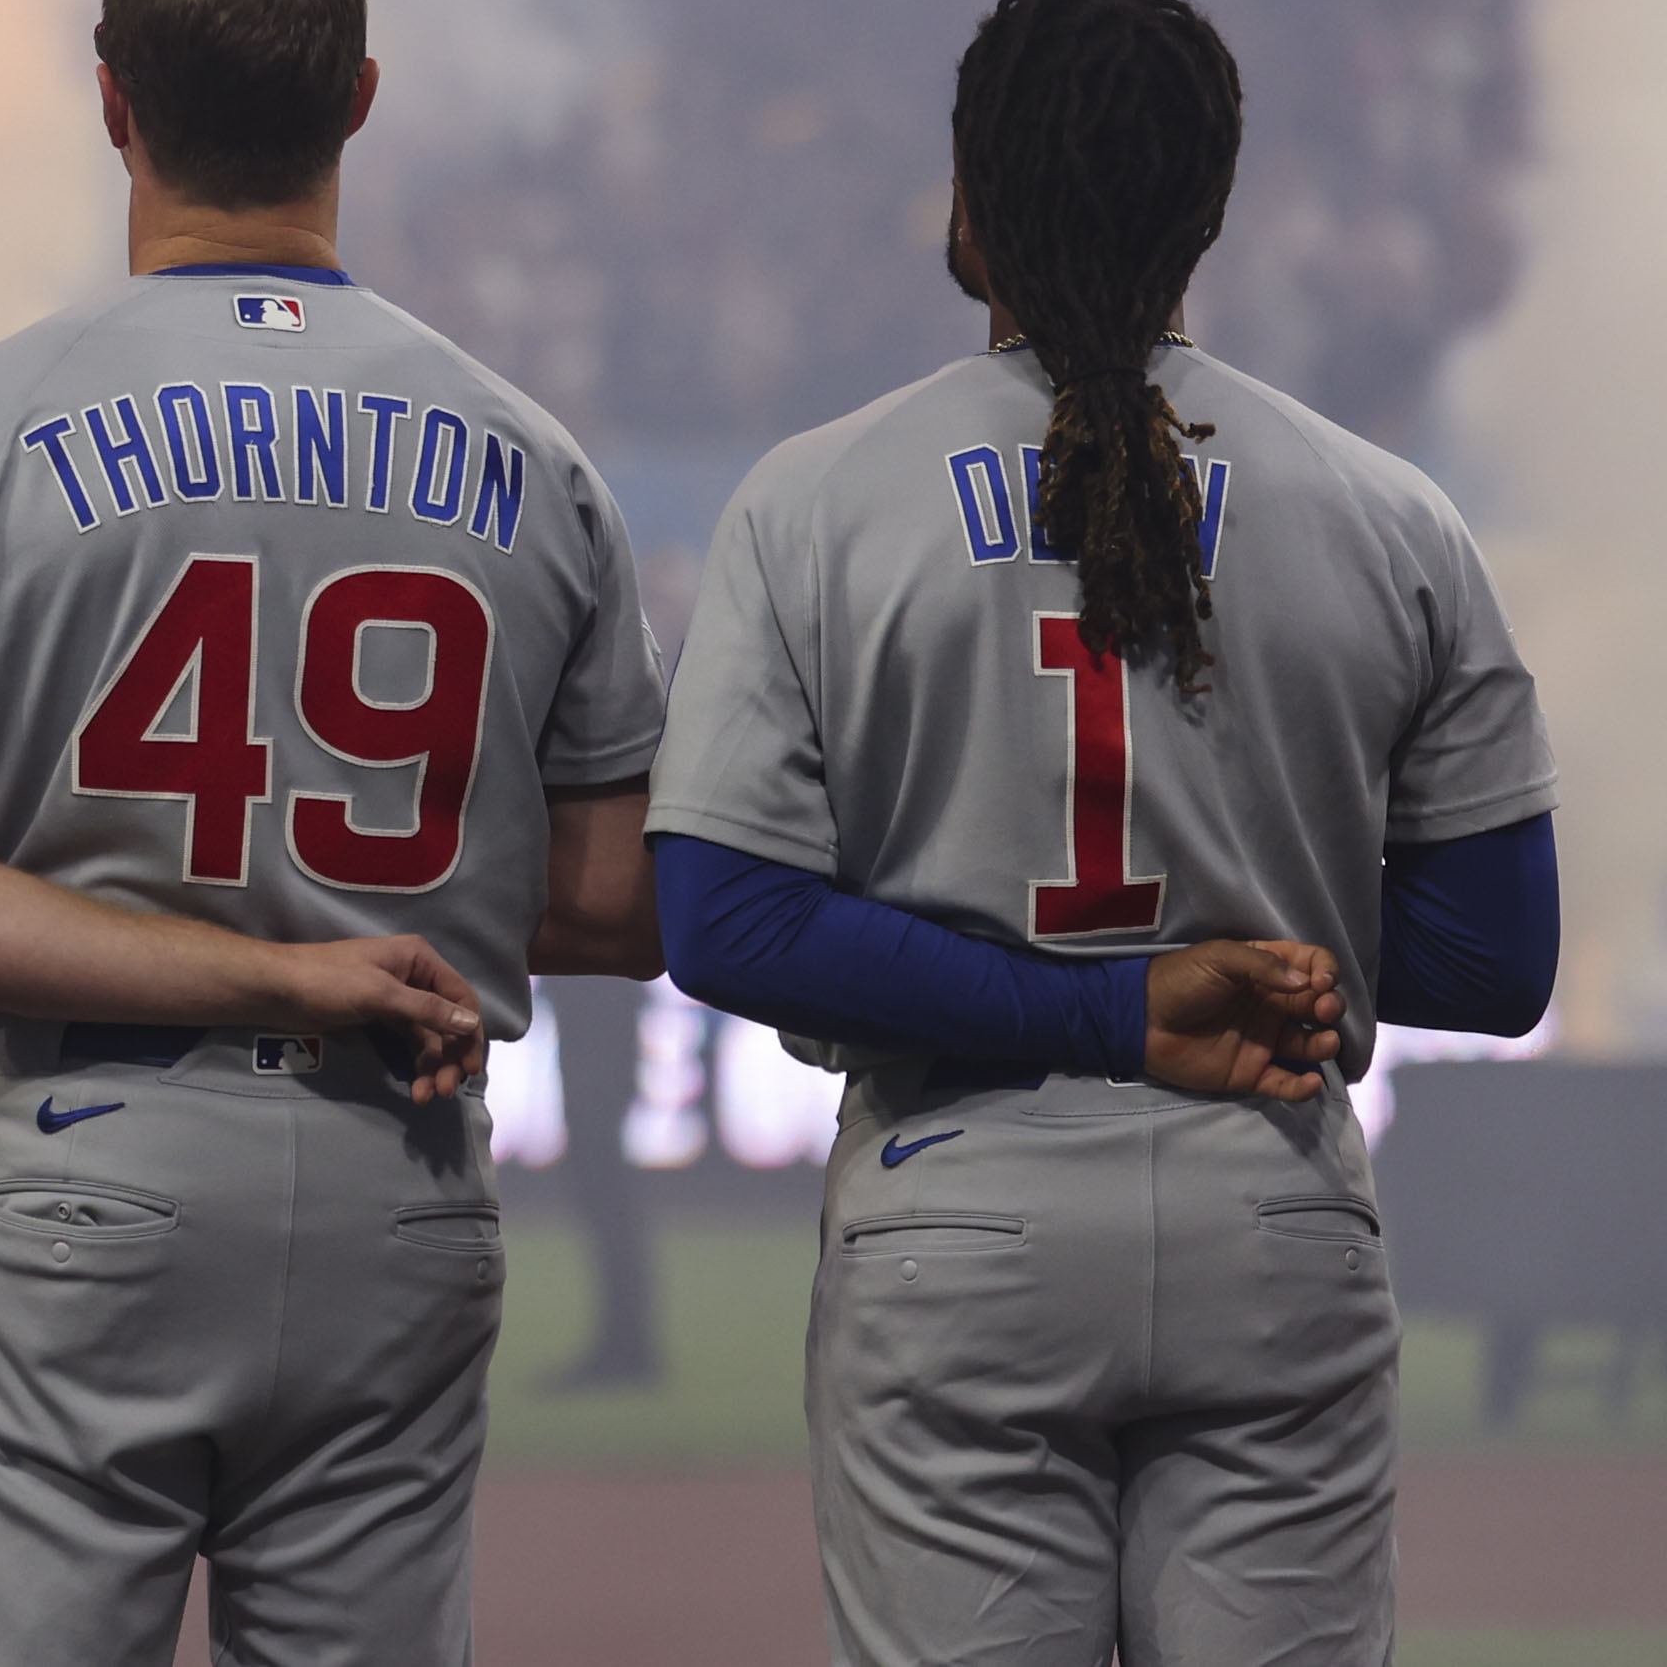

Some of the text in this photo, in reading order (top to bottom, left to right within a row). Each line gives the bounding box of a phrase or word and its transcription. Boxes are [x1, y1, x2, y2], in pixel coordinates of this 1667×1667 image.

[21, 383, 525, 552] THORNTON
[73, 555, 495, 892] 49
[1029, 613, 1166, 942] 1
